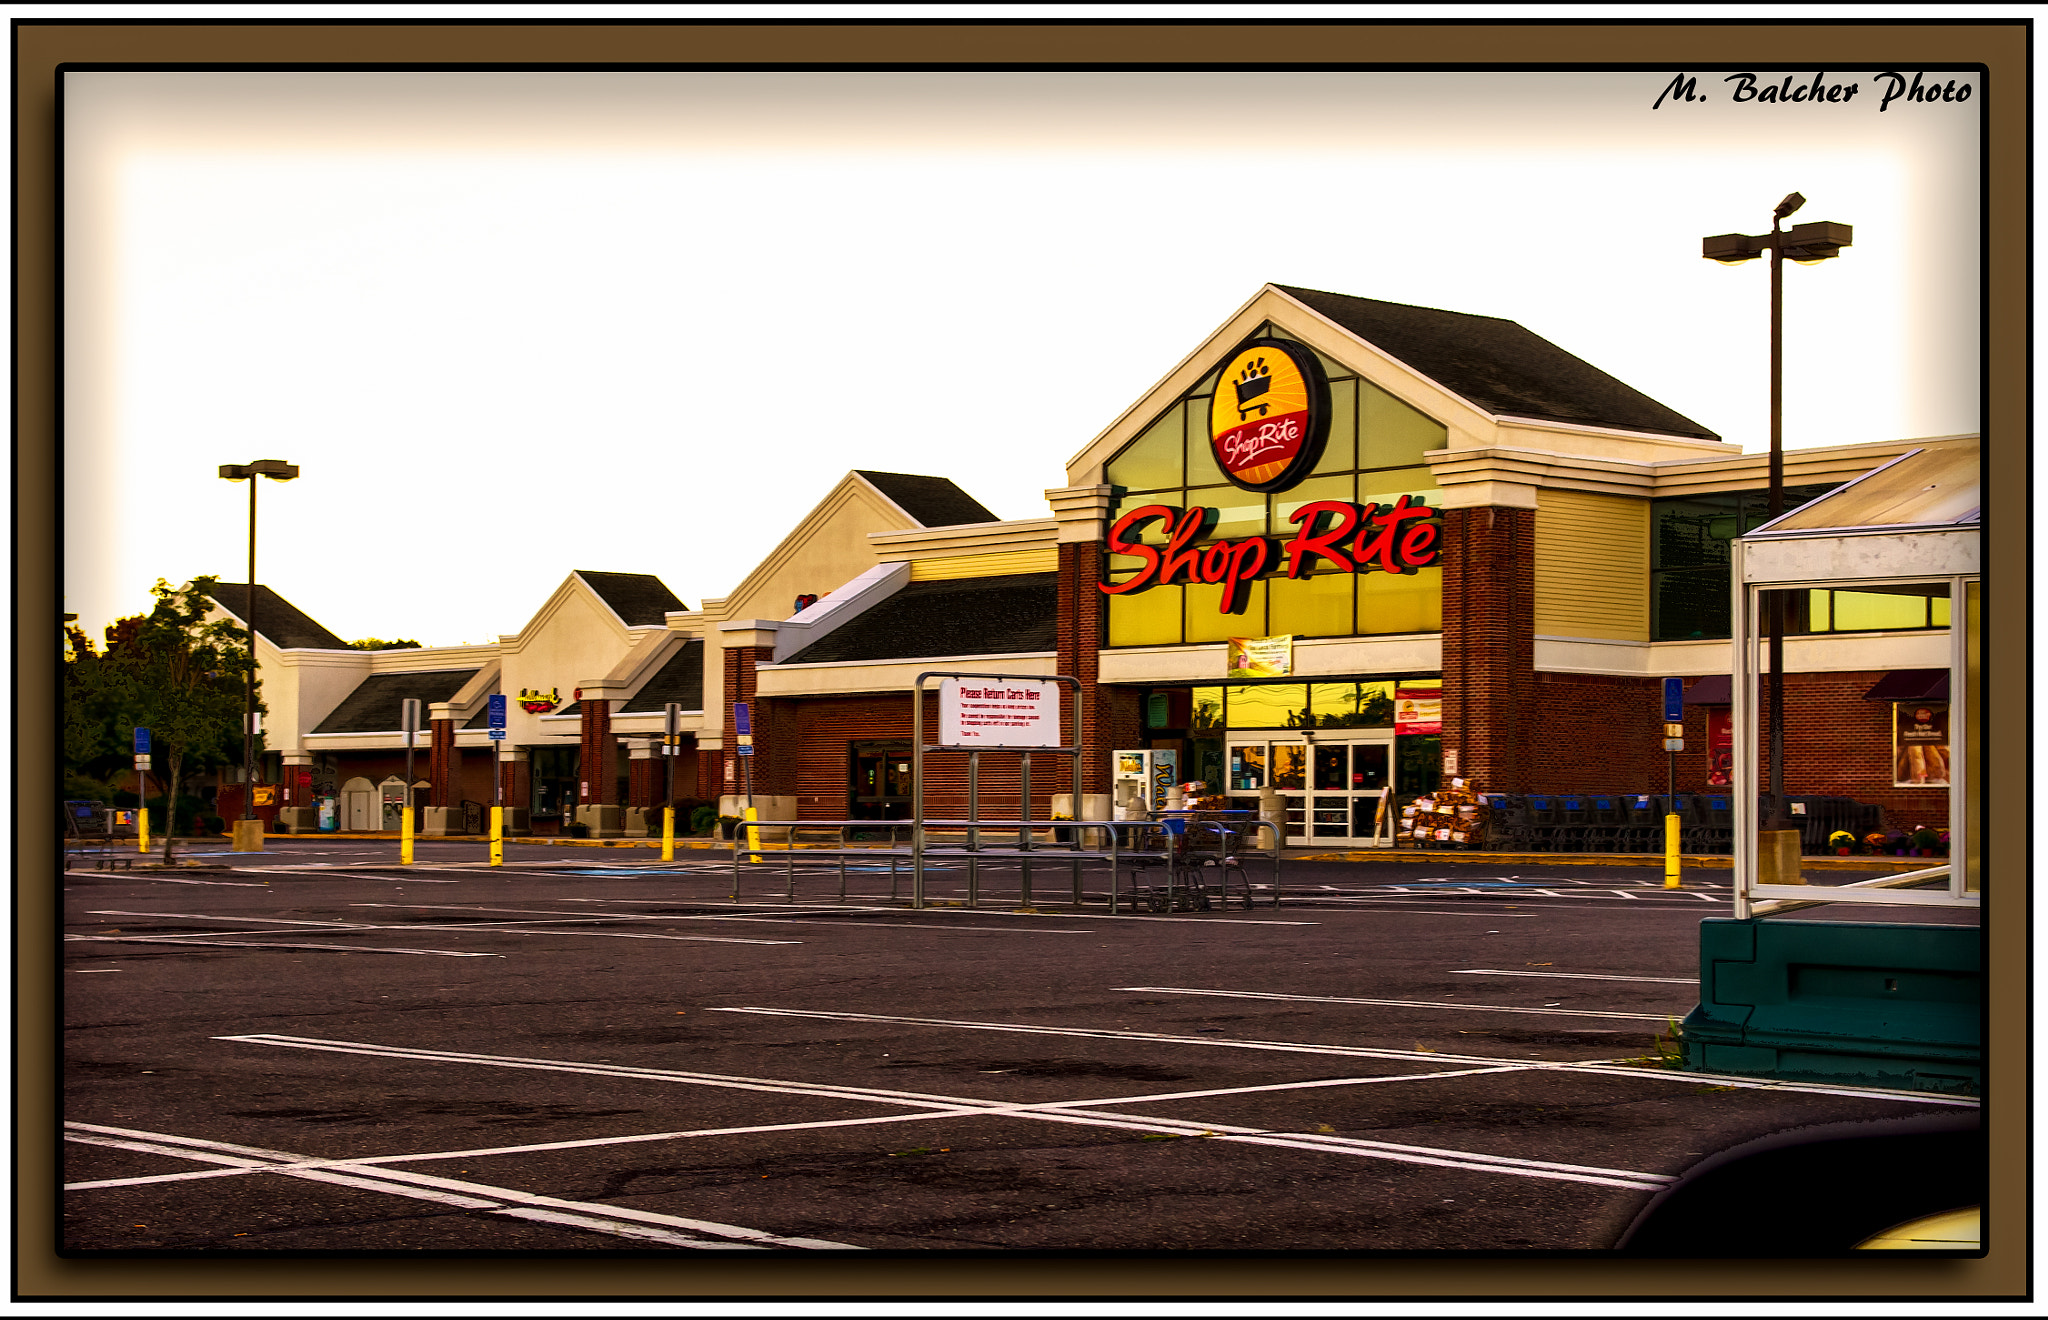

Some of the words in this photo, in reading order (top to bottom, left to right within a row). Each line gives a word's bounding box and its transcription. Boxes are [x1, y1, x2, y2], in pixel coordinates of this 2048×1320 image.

[1223, 417, 1299, 465] ShopRite
[960, 686, 982, 699] Please
[983, 687, 1005, 700] Return
[1006, 688, 1024, 700] Carts
[1025, 688, 1040, 701] Here
